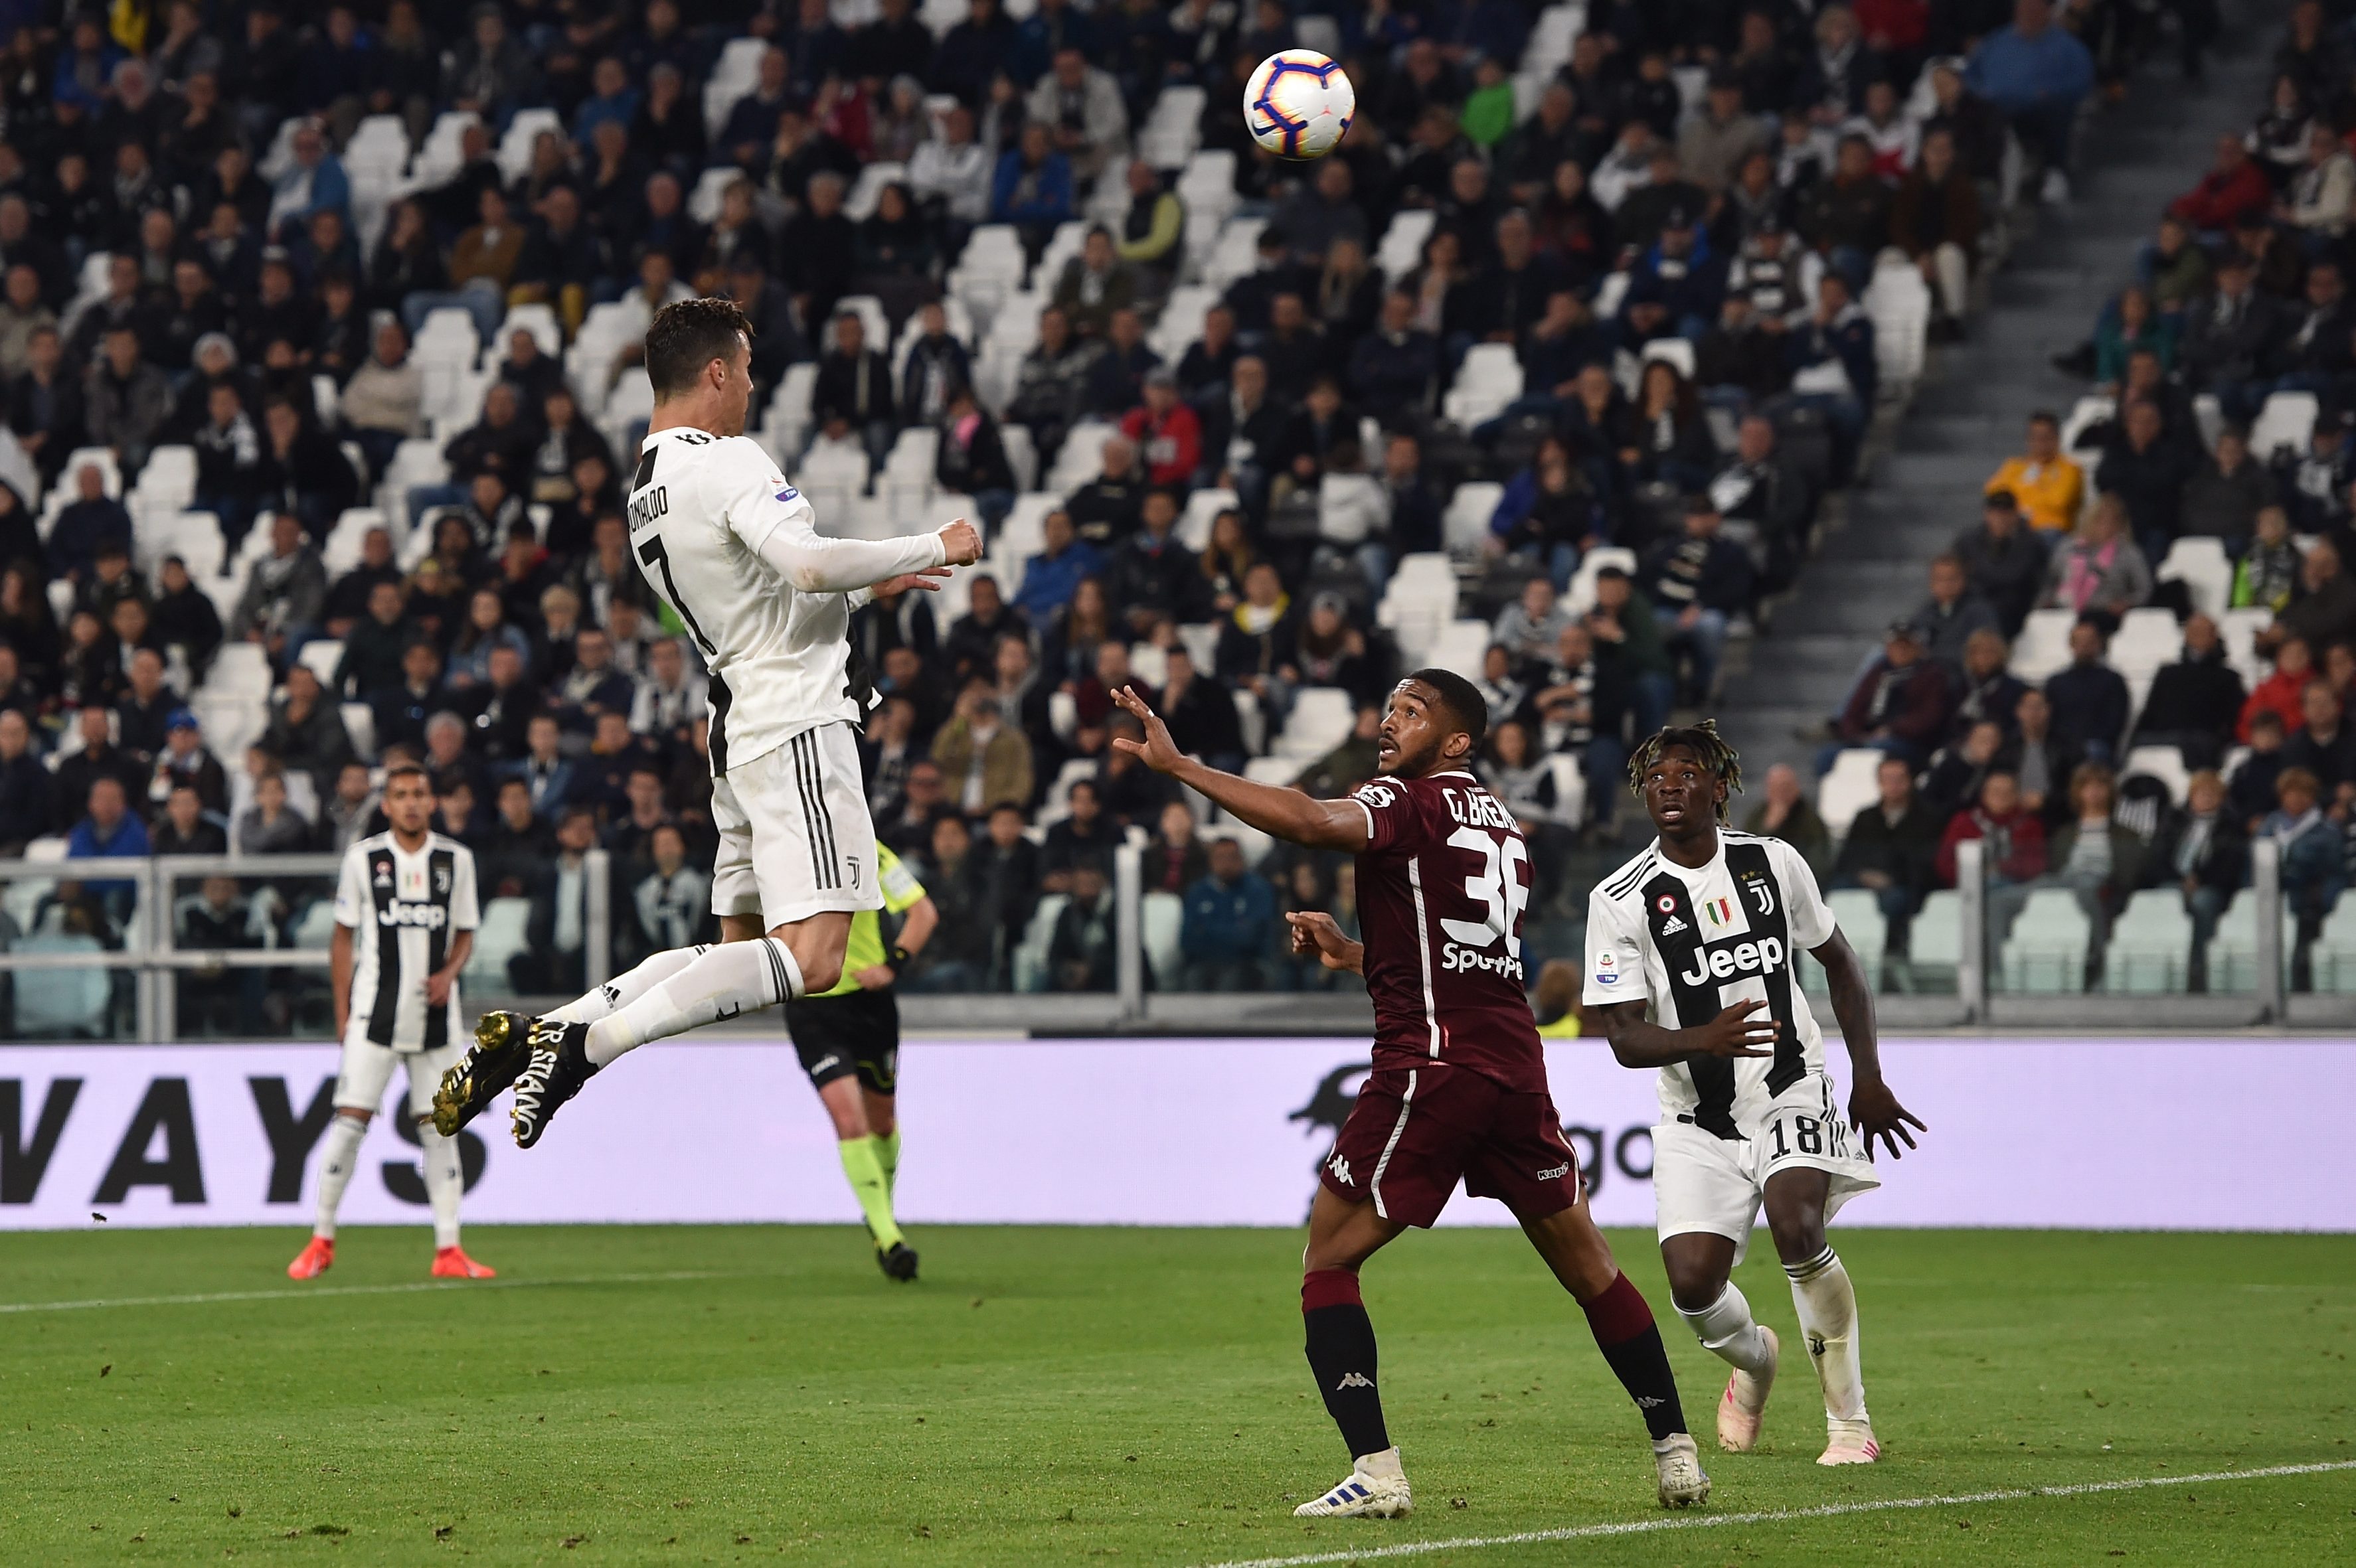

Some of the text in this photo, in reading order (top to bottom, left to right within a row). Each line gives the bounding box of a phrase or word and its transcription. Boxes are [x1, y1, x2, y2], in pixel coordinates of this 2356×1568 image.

[629, 485, 668, 534] ONALDO
[638, 533, 717, 656] 7
[379, 897, 446, 931] Jeep
[1662, 923, 1688, 937] adidas
[1681, 937, 1783, 986] Jeep
[1770, 1115, 1822, 1160] 18
